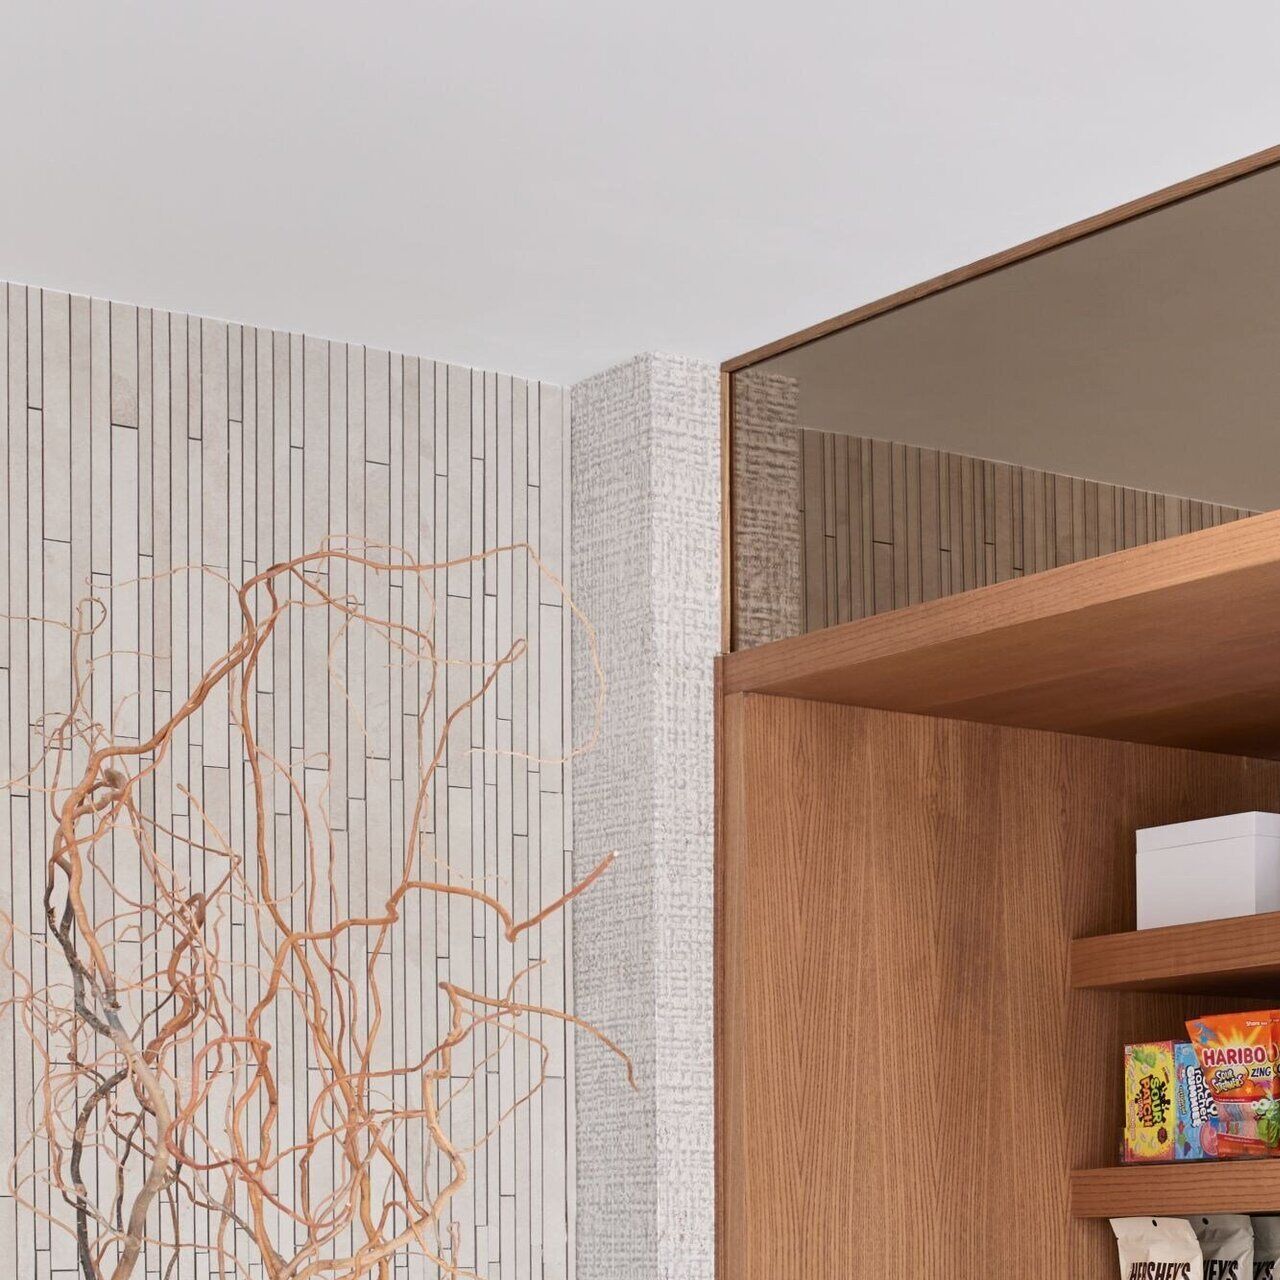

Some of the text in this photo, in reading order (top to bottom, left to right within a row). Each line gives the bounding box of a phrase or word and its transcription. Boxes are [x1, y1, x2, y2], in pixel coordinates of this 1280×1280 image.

[1203, 1047, 1266, 1066] HARIBO
[1251, 1067, 1271, 1077] Z!NG
[1150, 1077, 1163, 1124] SOUR
